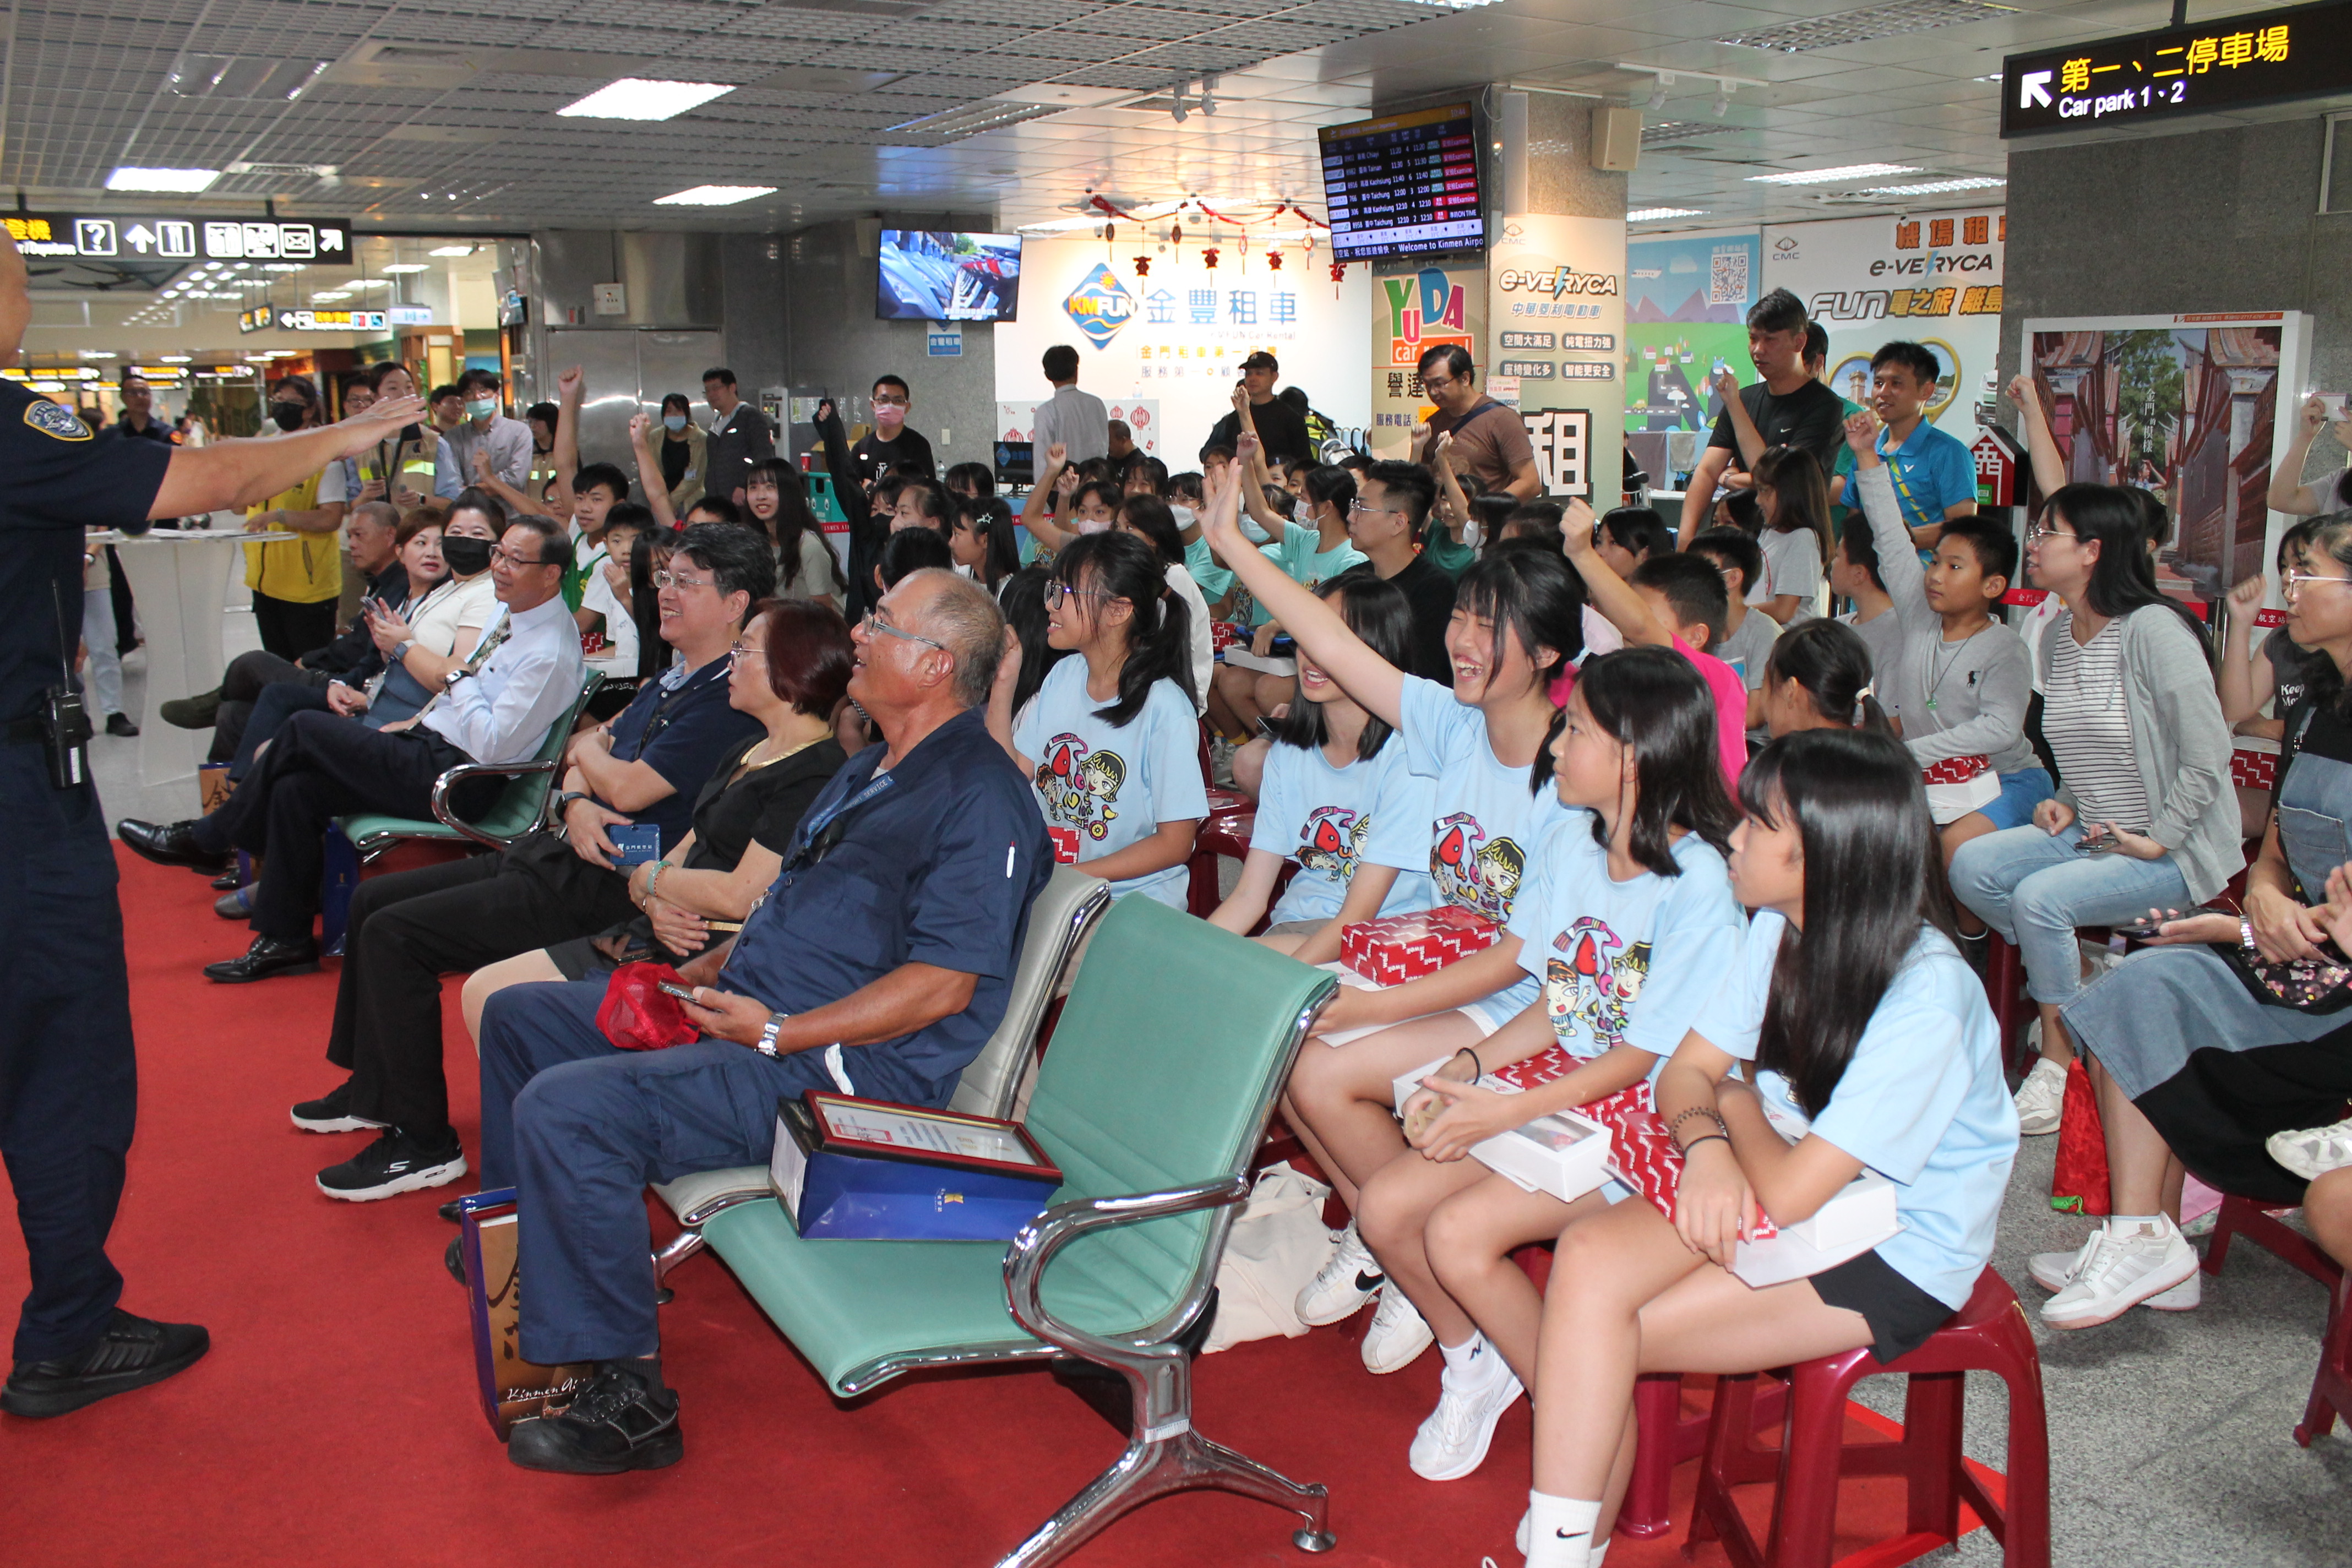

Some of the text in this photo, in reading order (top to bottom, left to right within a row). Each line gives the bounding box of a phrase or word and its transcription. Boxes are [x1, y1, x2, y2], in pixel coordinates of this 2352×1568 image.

[2060, 25, 2290, 93] 第一、二停車場
[2058, 97, 2092, 119] Car
[2094, 89, 2136, 119] park
[1416, 171, 1429, 179] 11:40
[1417, 186, 1430, 194] 12:00
[1396, 202, 1408, 210] 12:10
[1419, 199, 1431, 208] 12:10
[1420, 214, 1433, 222] 12:10
[1398, 241, 1428, 253] Welcome
[1438, 239, 1463, 249] Kinmen
[1772, 252, 1800, 260] CMC
[1069, 295, 1136, 318] KMFUN
[1146, 288, 1297, 325] 金豐租車
[1382, 268, 1465, 344] YUDA
[1504, 334, 1551, 347] 空間大滿足
[1566, 335, 1611, 349] 純電扭力強
[1395, 345, 1418, 361] car
[1504, 363, 1551, 377] 座椅變化多
[1566, 364, 1610, 377] 智能更安全
[1524, 411, 1588, 498] 租
[2255, 613, 2286, 624] 航空站
[2281, 683, 2305, 698] Keep
[1407, 946, 1420, 955] well
[1442, 939, 1455, 948] well
[1387, 965, 1401, 973] well
[507, 1387, 559, 1401] Kinmen
